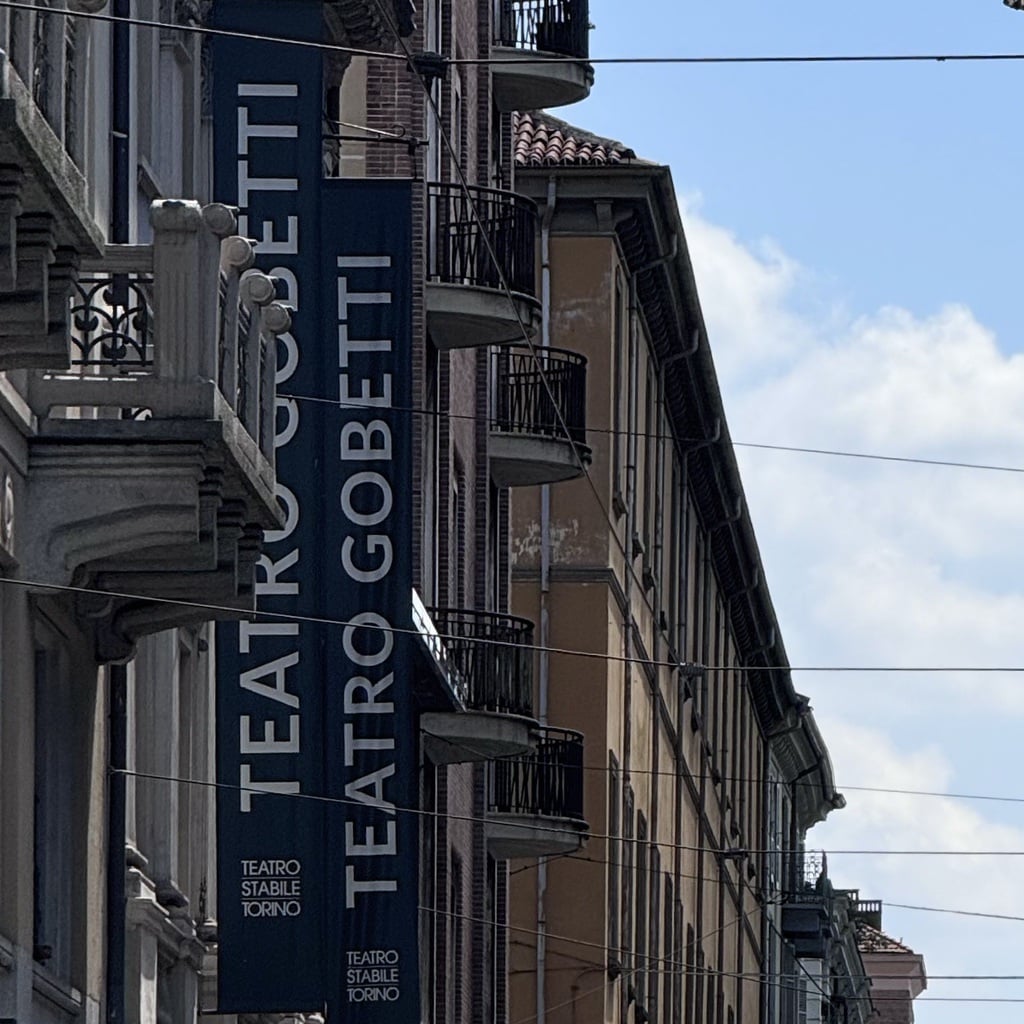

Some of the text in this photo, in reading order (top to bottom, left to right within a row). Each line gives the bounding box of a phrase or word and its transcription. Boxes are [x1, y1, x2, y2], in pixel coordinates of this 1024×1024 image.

[337, 255, 397, 909] TEATRO GOBETTI
[240, 859, 301, 876] TEATRO
[241, 880, 301, 897] STABILE
[241, 901, 301, 917] TORINO
[346, 950, 399, 965] TEATRO
[346, 968, 399, 984] STABILE
[346, 987, 400, 1002] TORINO
